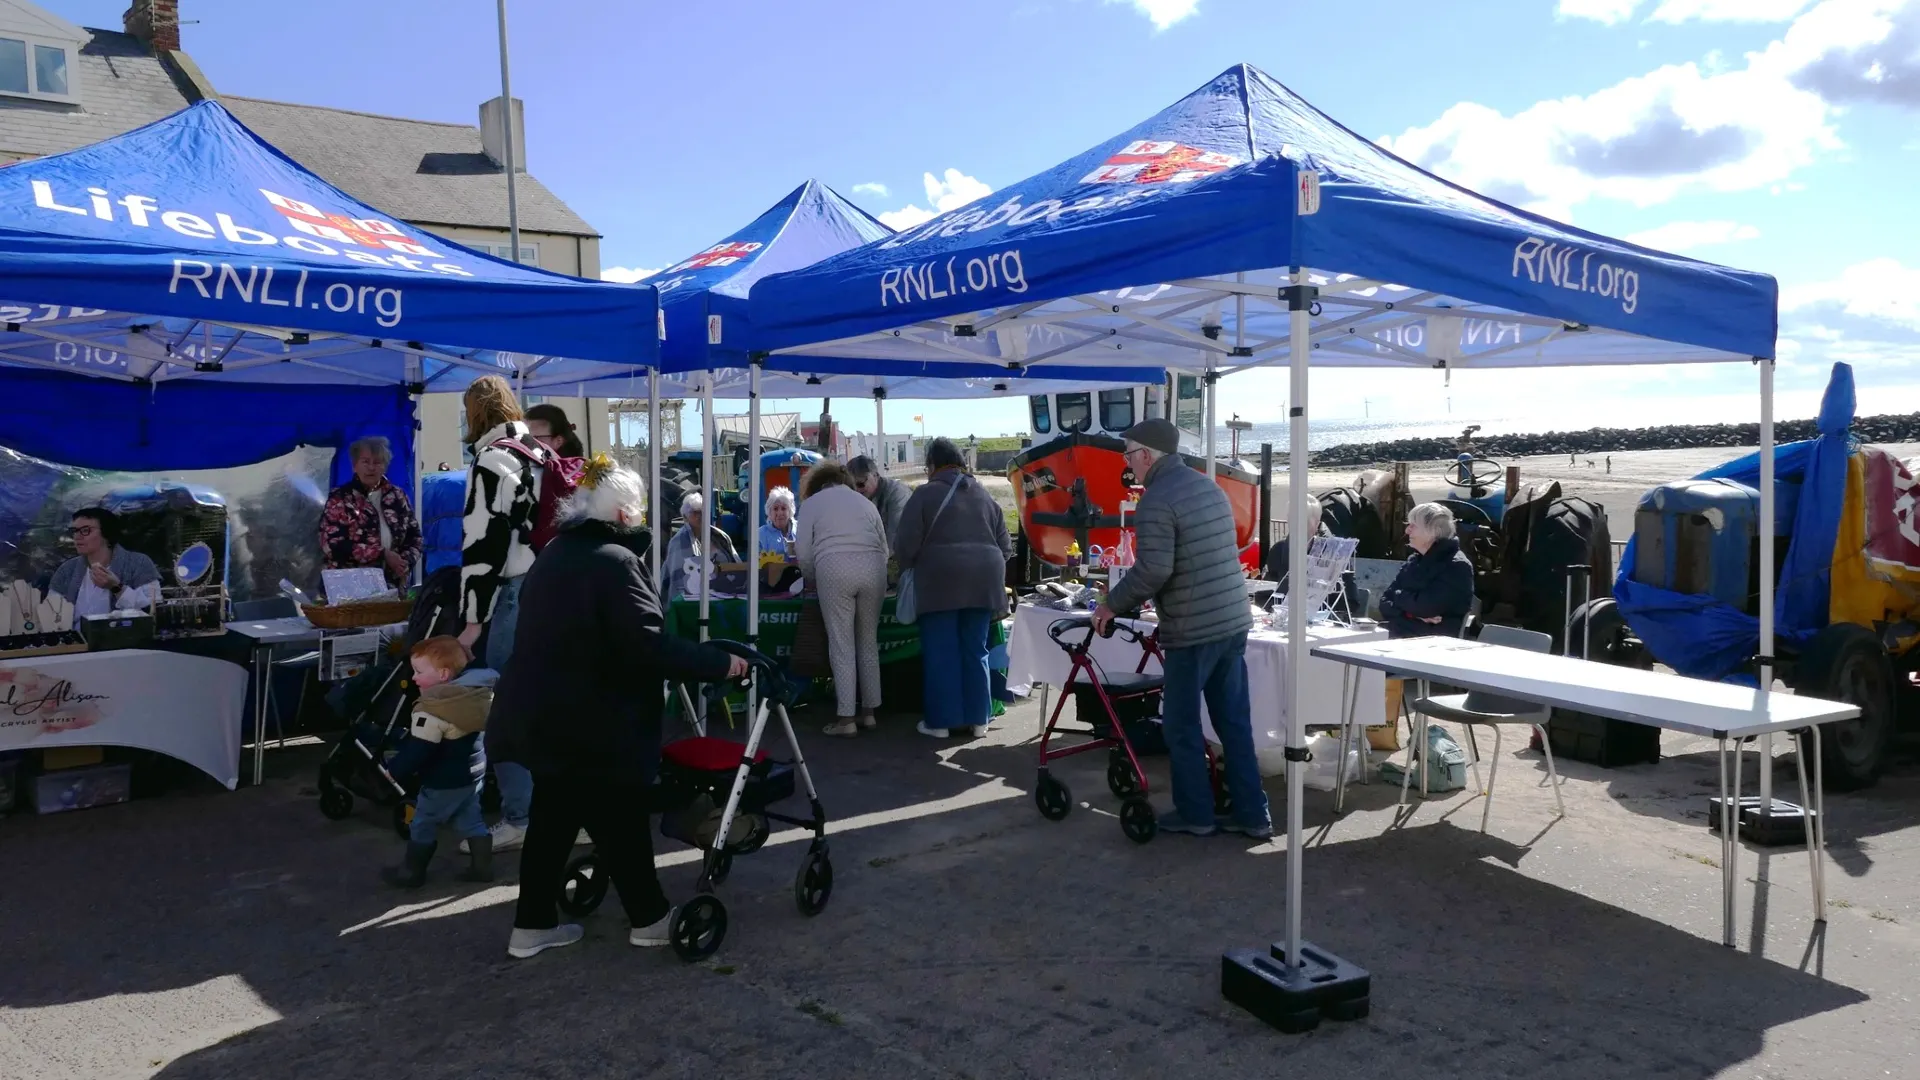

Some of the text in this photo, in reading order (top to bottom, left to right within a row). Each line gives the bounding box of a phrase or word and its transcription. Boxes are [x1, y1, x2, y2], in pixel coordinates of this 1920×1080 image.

[31, 179, 475, 277] Lifeboats
[168, 258, 403, 328] RNLI.org
[880, 249, 1028, 308] RNLI.org
[1512, 236, 1639, 315] RNLI.org
[0, 719, 37, 729] CRYLIC
